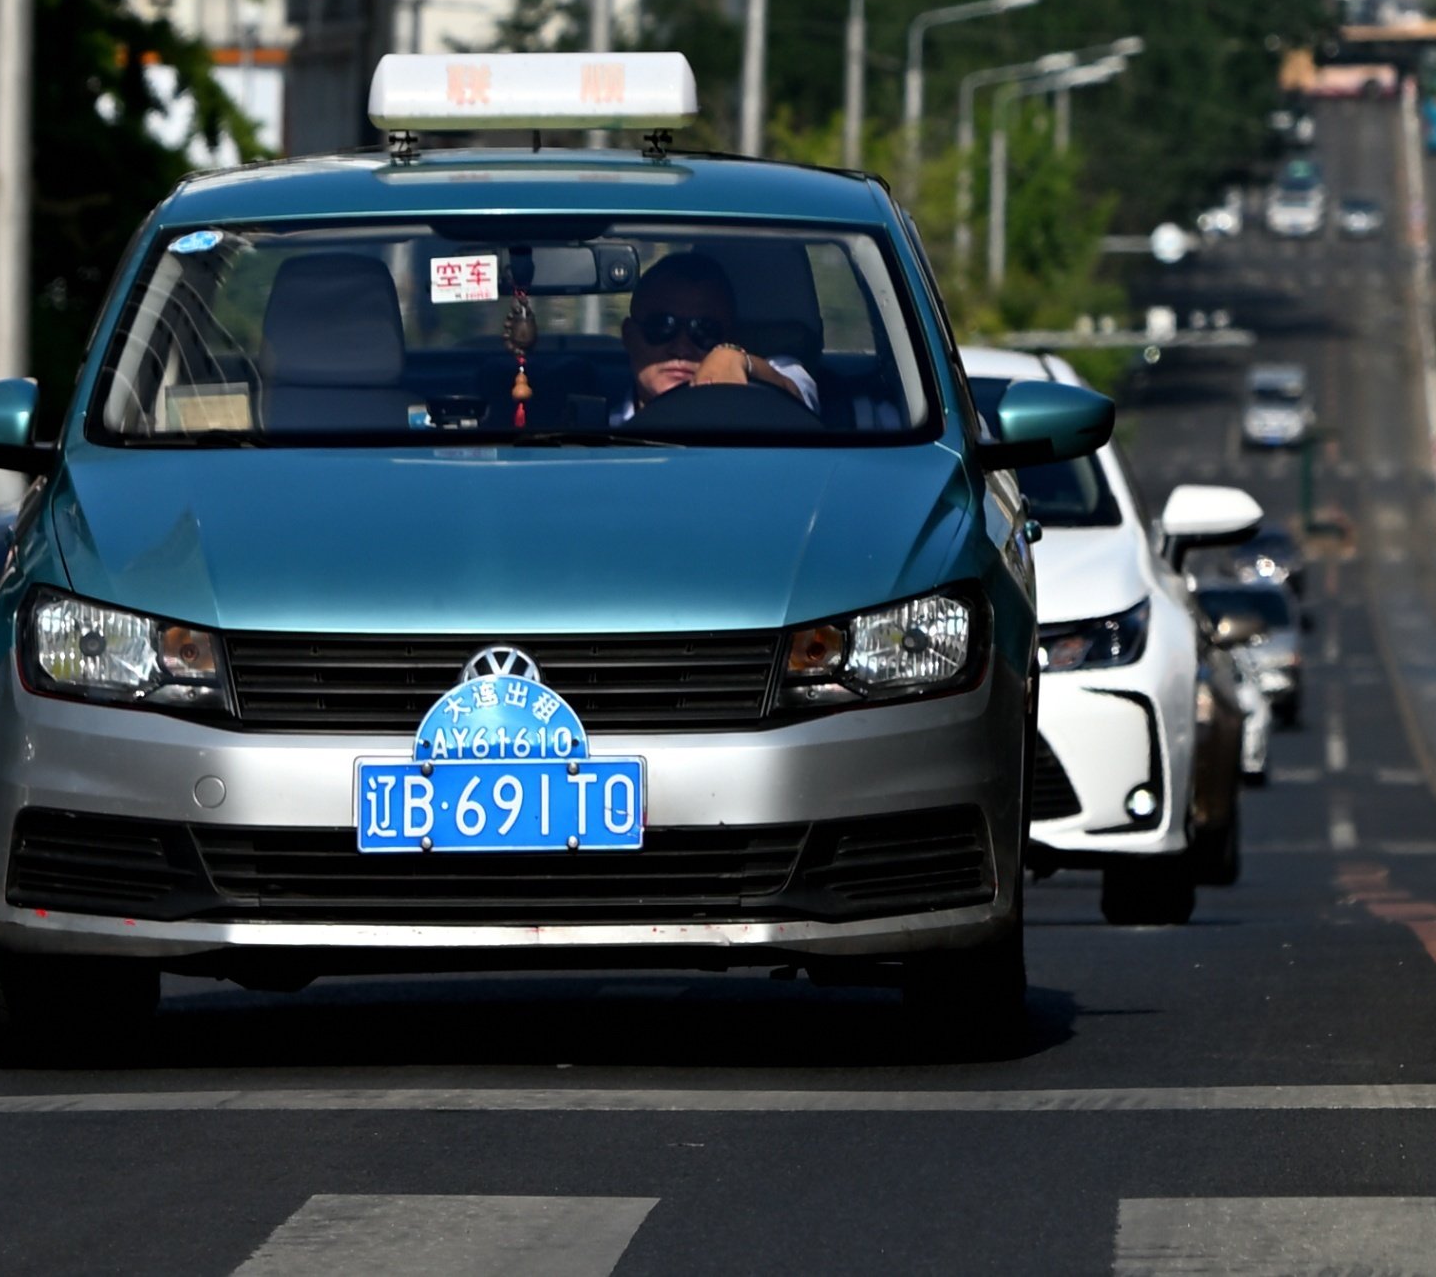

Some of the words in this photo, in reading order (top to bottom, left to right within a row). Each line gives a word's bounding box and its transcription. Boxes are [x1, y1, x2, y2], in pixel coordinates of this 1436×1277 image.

[436, 259, 491, 288] 空车
[443, 681, 562, 724] 大连出租
[431, 726, 573, 759] AY61610
